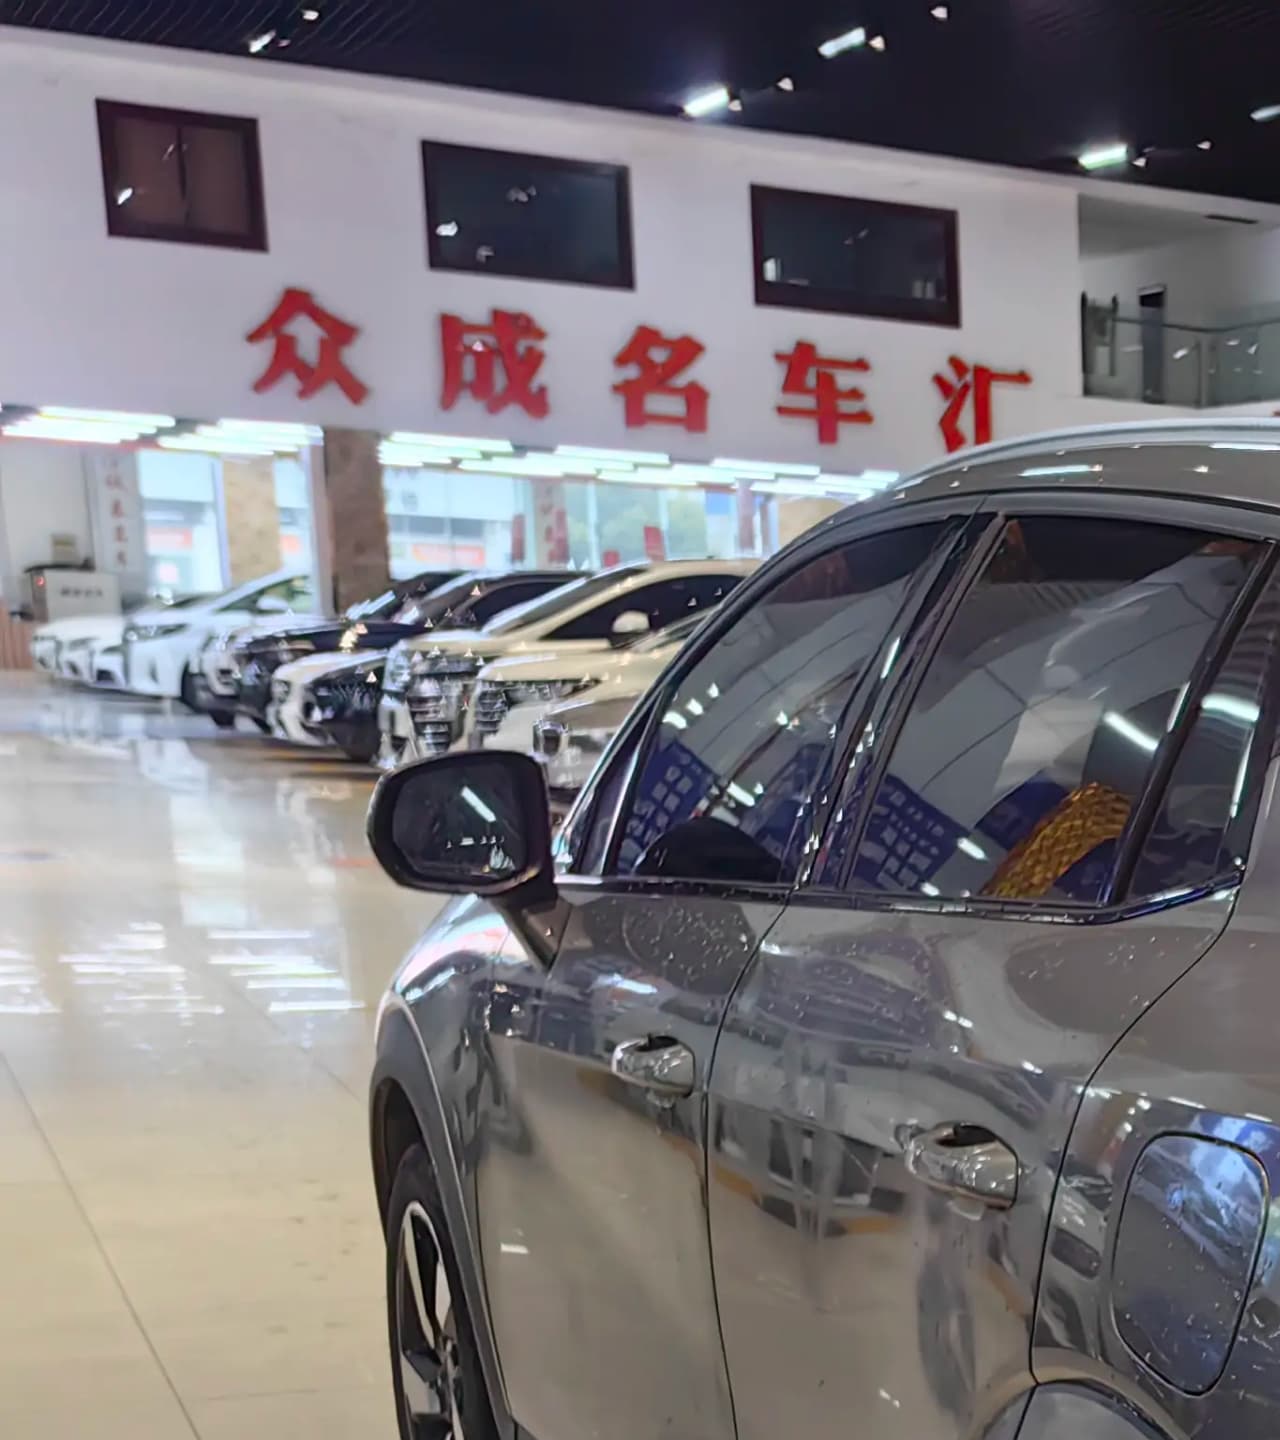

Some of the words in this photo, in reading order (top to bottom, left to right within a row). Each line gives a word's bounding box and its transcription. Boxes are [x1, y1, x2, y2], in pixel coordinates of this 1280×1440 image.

[246, 287, 1033, 453] 众成名车汇
